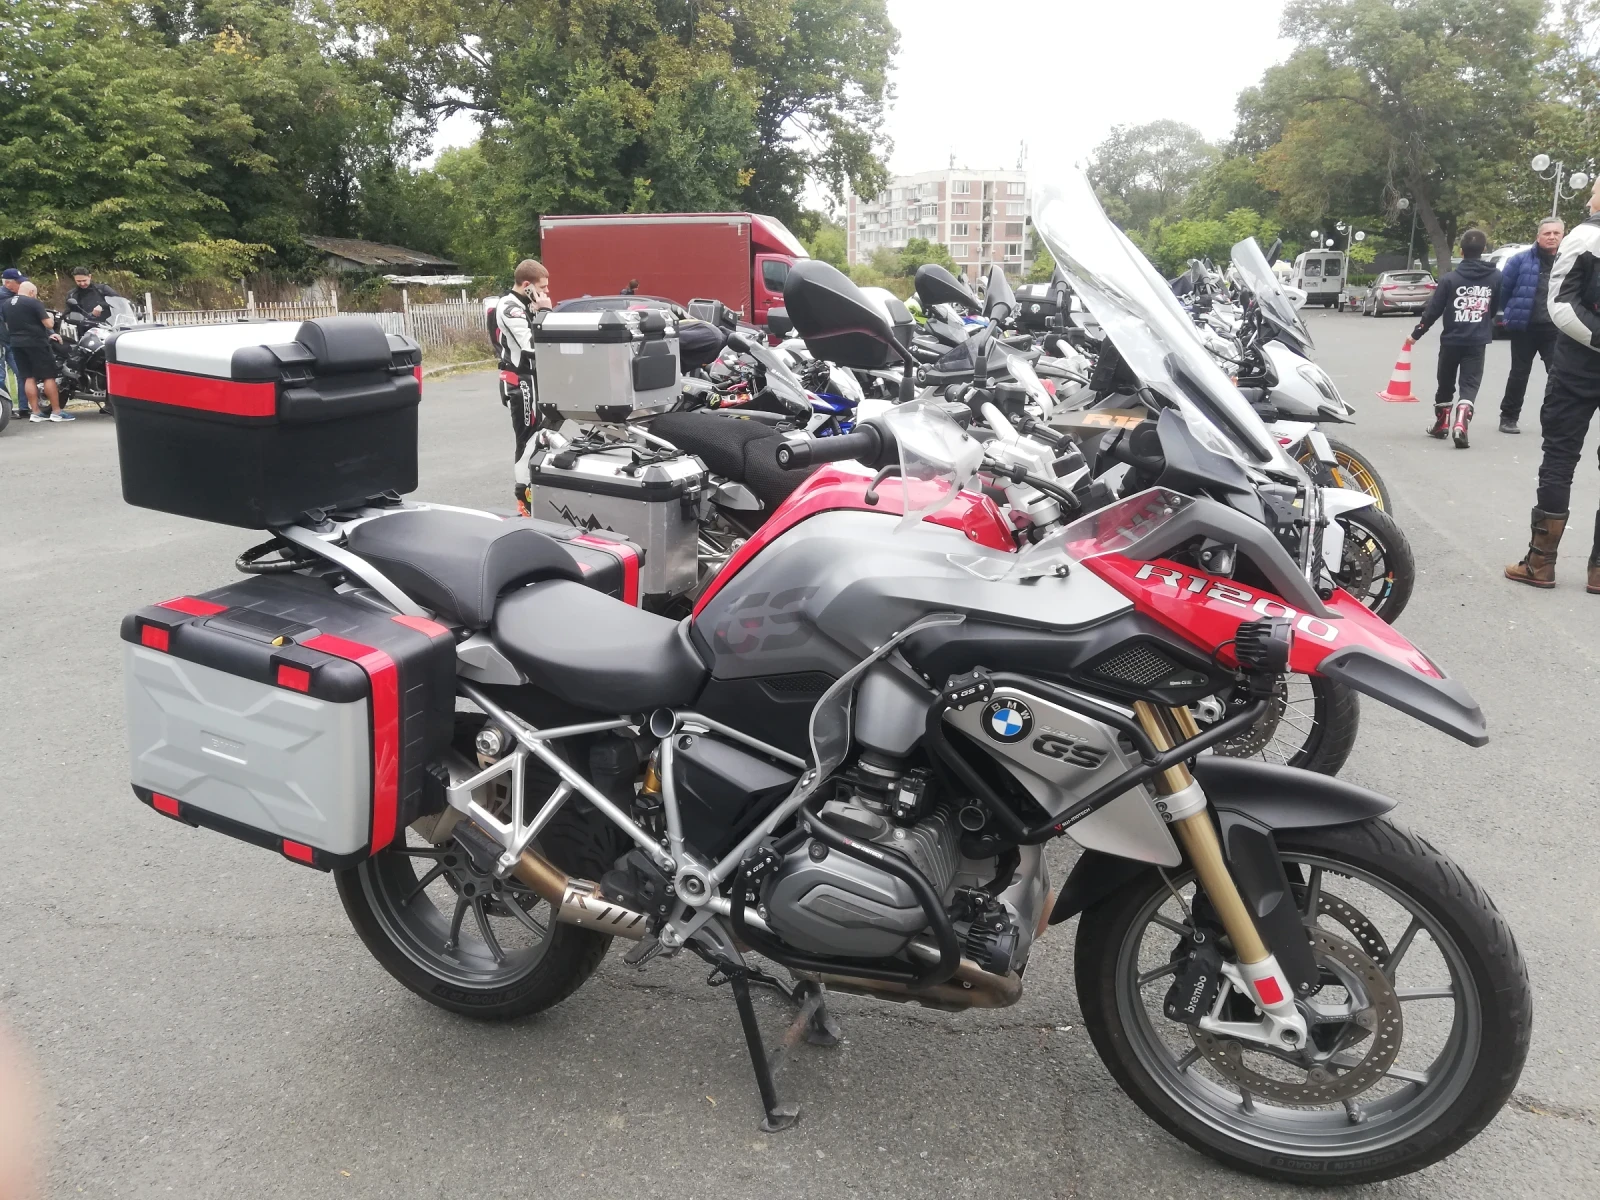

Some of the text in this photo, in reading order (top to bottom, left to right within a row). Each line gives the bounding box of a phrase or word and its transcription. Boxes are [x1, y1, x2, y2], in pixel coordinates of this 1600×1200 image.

[1455, 285, 1492, 297] COME
[1453, 297, 1490, 310] GET
[1454, 310, 1482, 323] ME
[1134, 563, 1340, 642] R1200
[960, 687, 976, 697] GS
[991, 701, 1031, 720] BMW
[1032, 733, 1109, 770] GS
[1184, 975, 1207, 1014] brembo
